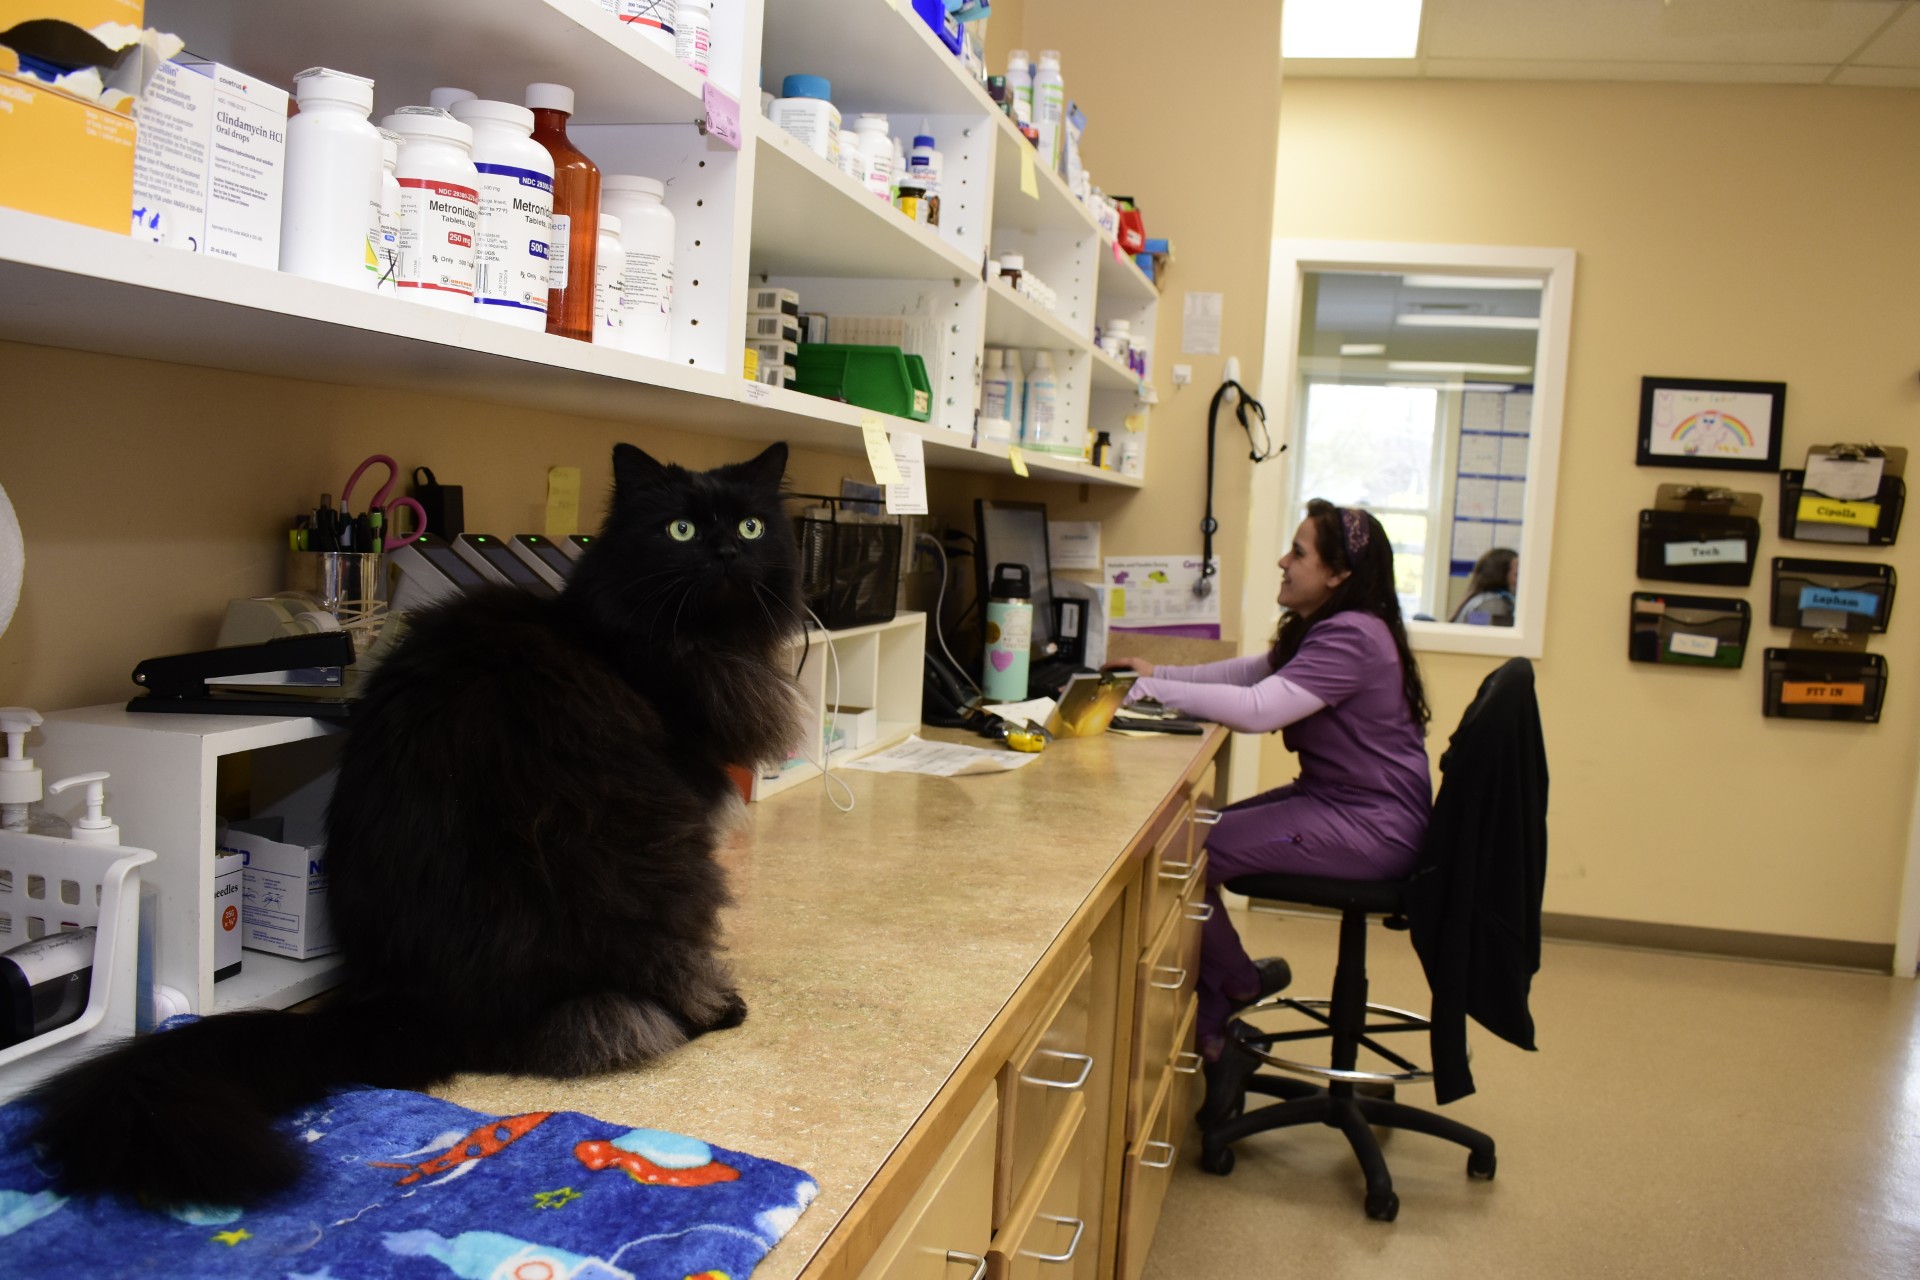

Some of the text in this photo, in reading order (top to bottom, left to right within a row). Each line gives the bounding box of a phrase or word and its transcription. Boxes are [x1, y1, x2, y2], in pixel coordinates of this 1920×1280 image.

[219, 77, 242, 90] covetrus
[216, 124, 250, 143] Oral drops
[217, 111, 283, 144] Clindamycin HCl
[523, 176, 536, 186] NDC
[438, 187, 452, 196] NDC
[449, 233, 472, 248] 250 mg
[530, 242, 543, 253] 500
[441, 256, 453, 265] Only
[1816, 506, 1857, 519] Cipolla
[1691, 547, 1721, 557] Tech
[1812, 593, 1859, 608] Lapham
[1806, 687, 1844, 697] FIT IN
